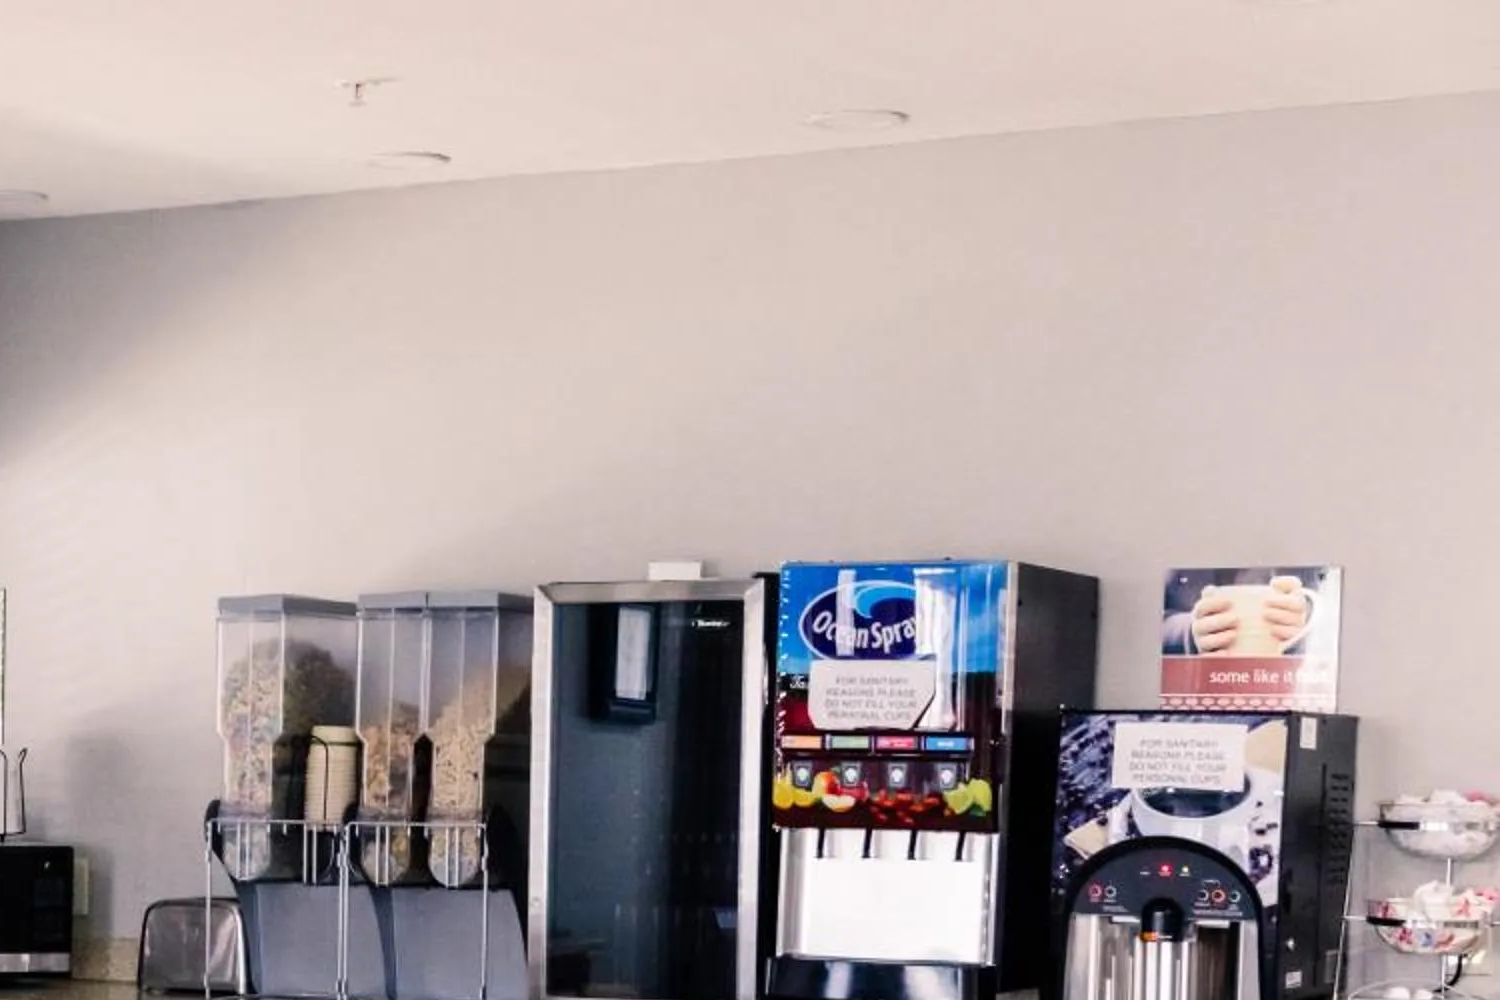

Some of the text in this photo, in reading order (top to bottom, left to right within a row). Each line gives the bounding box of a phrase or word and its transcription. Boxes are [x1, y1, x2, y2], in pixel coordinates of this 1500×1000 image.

[871, 615, 918, 654] Spra
[1209, 671, 1249, 684] some
[1252, 669, 1280, 683] like
